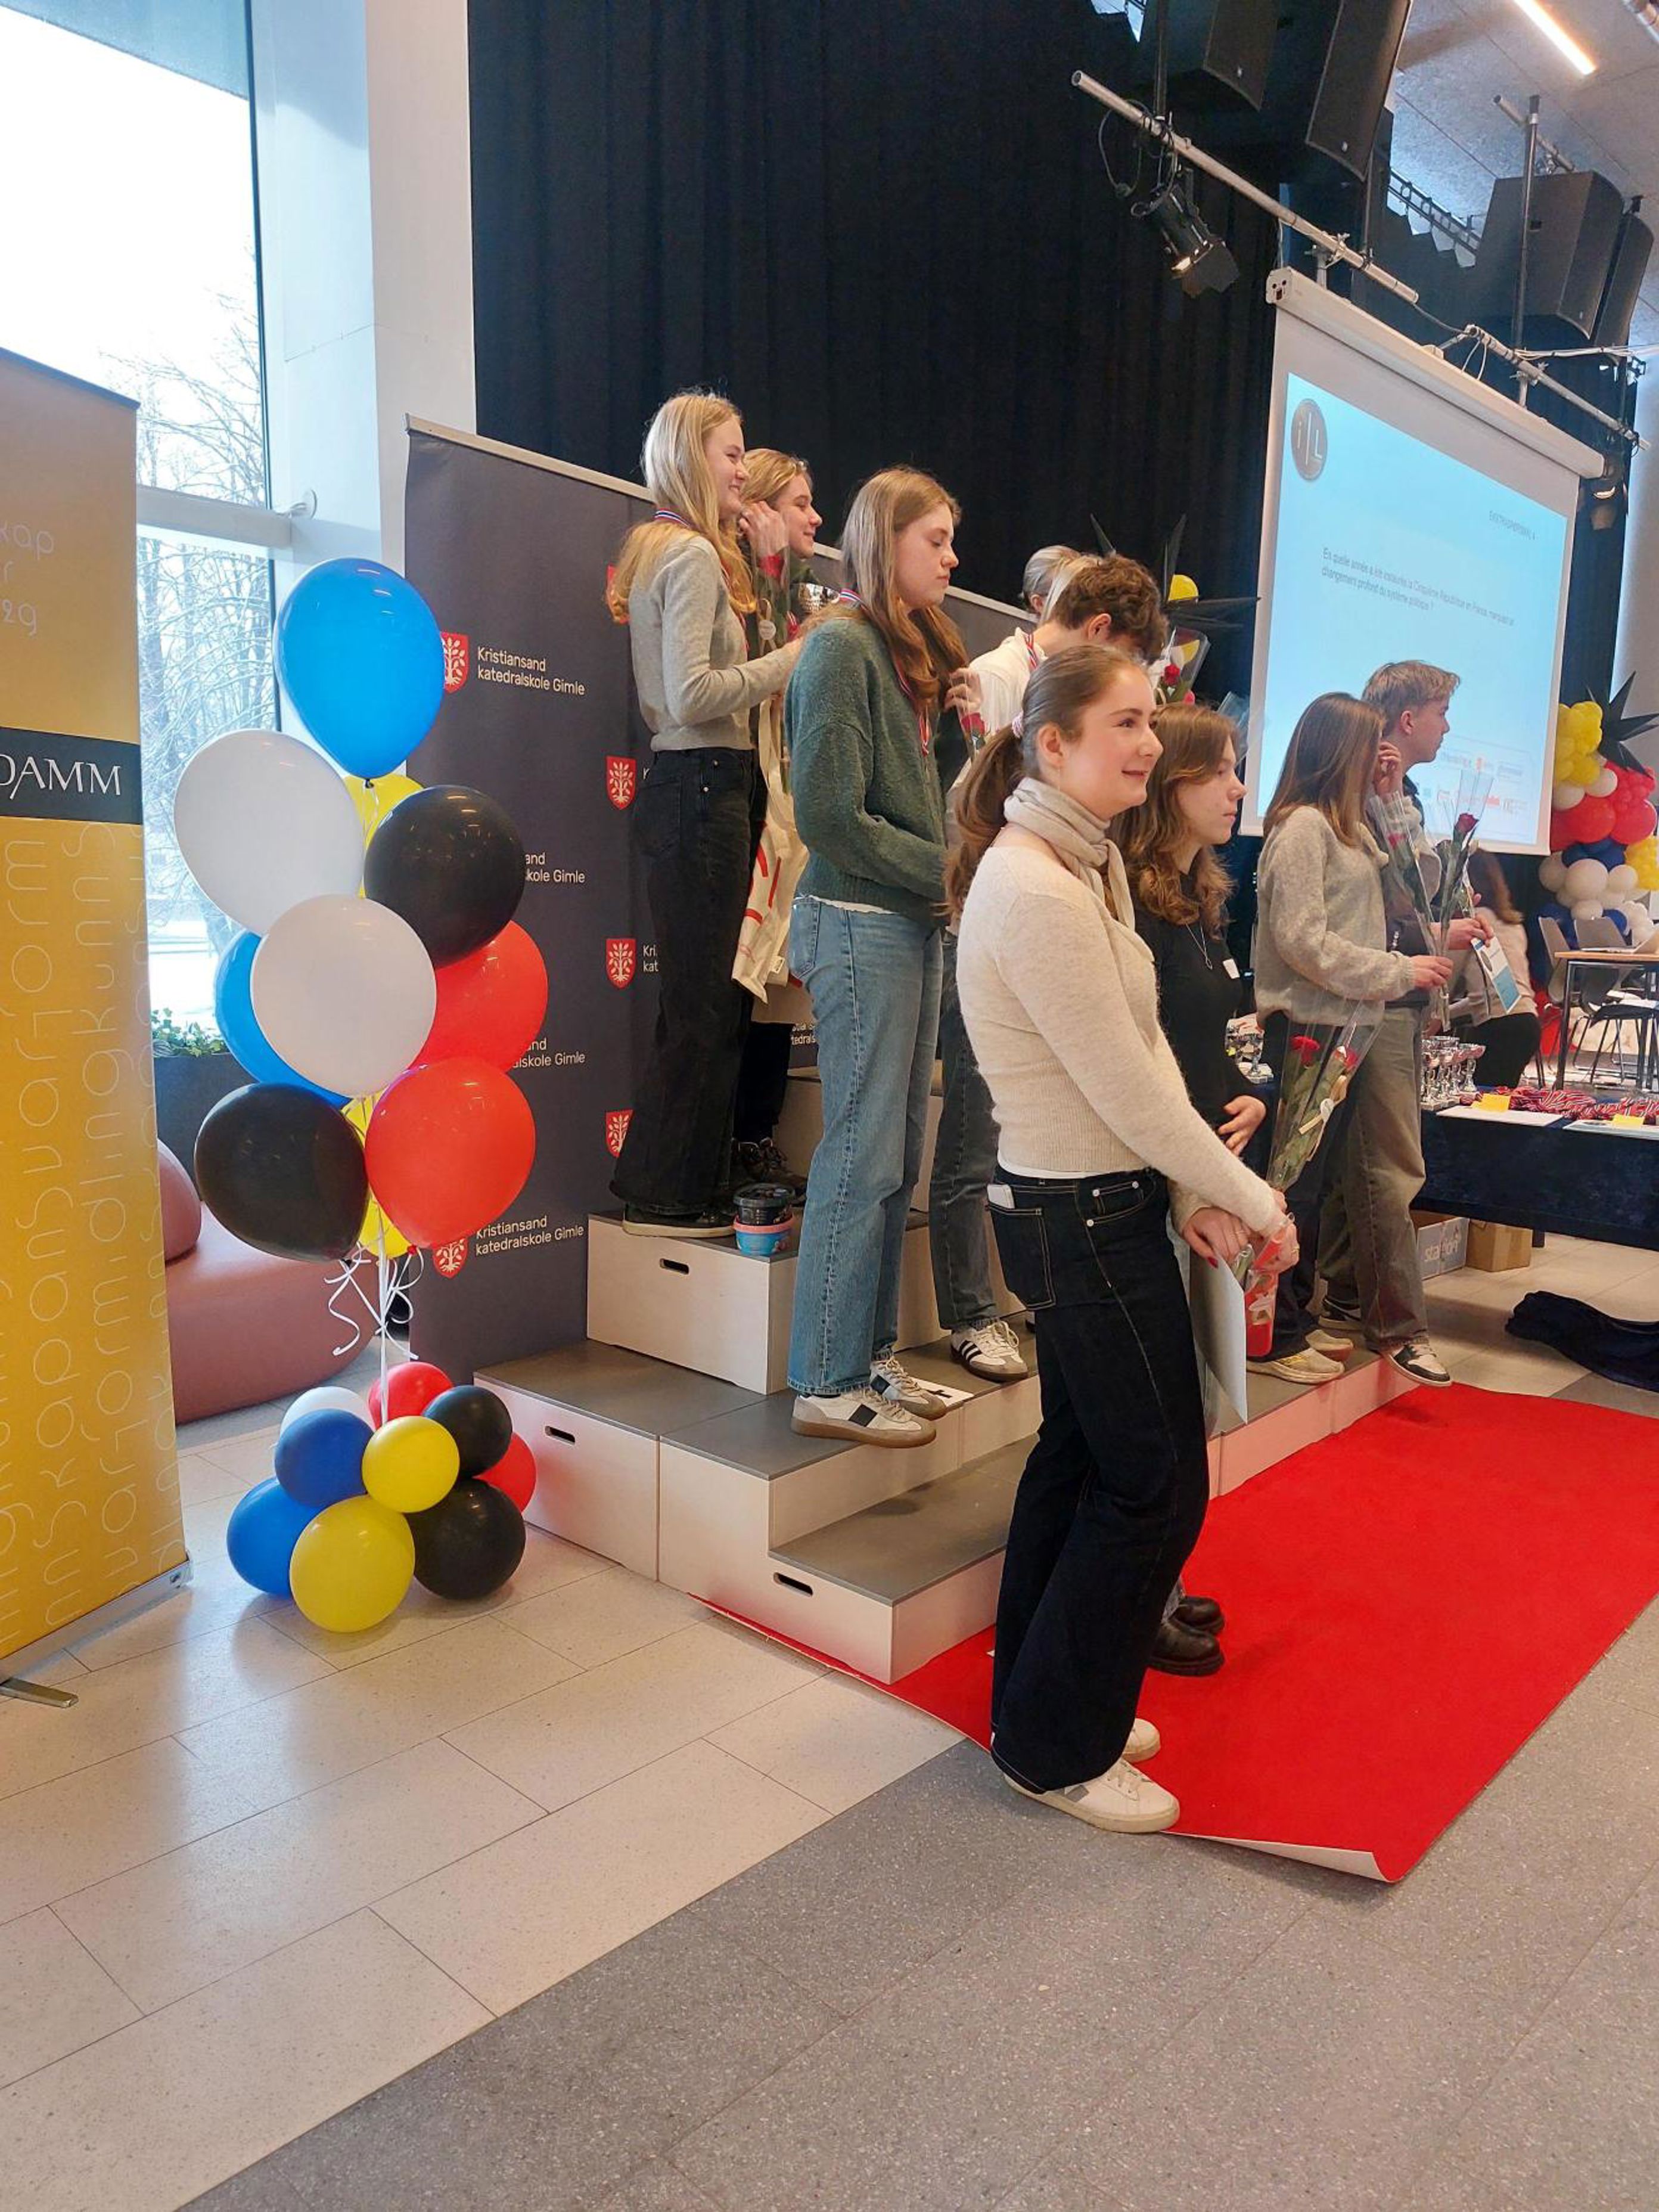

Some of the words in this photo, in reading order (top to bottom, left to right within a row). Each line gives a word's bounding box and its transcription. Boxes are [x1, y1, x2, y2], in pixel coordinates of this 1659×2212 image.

[478, 646, 546, 672] Kristiansand
[478, 665, 551, 691] katedralskole
[553, 678, 585, 696] Gimle
[553, 869, 586, 883] Gimle
[554, 1050, 586, 1066] Gimle
[476, 1215, 548, 1240] Kristiansand
[476, 1231, 552, 1257] katedralskole
[554, 1224, 585, 1241] Gimle
